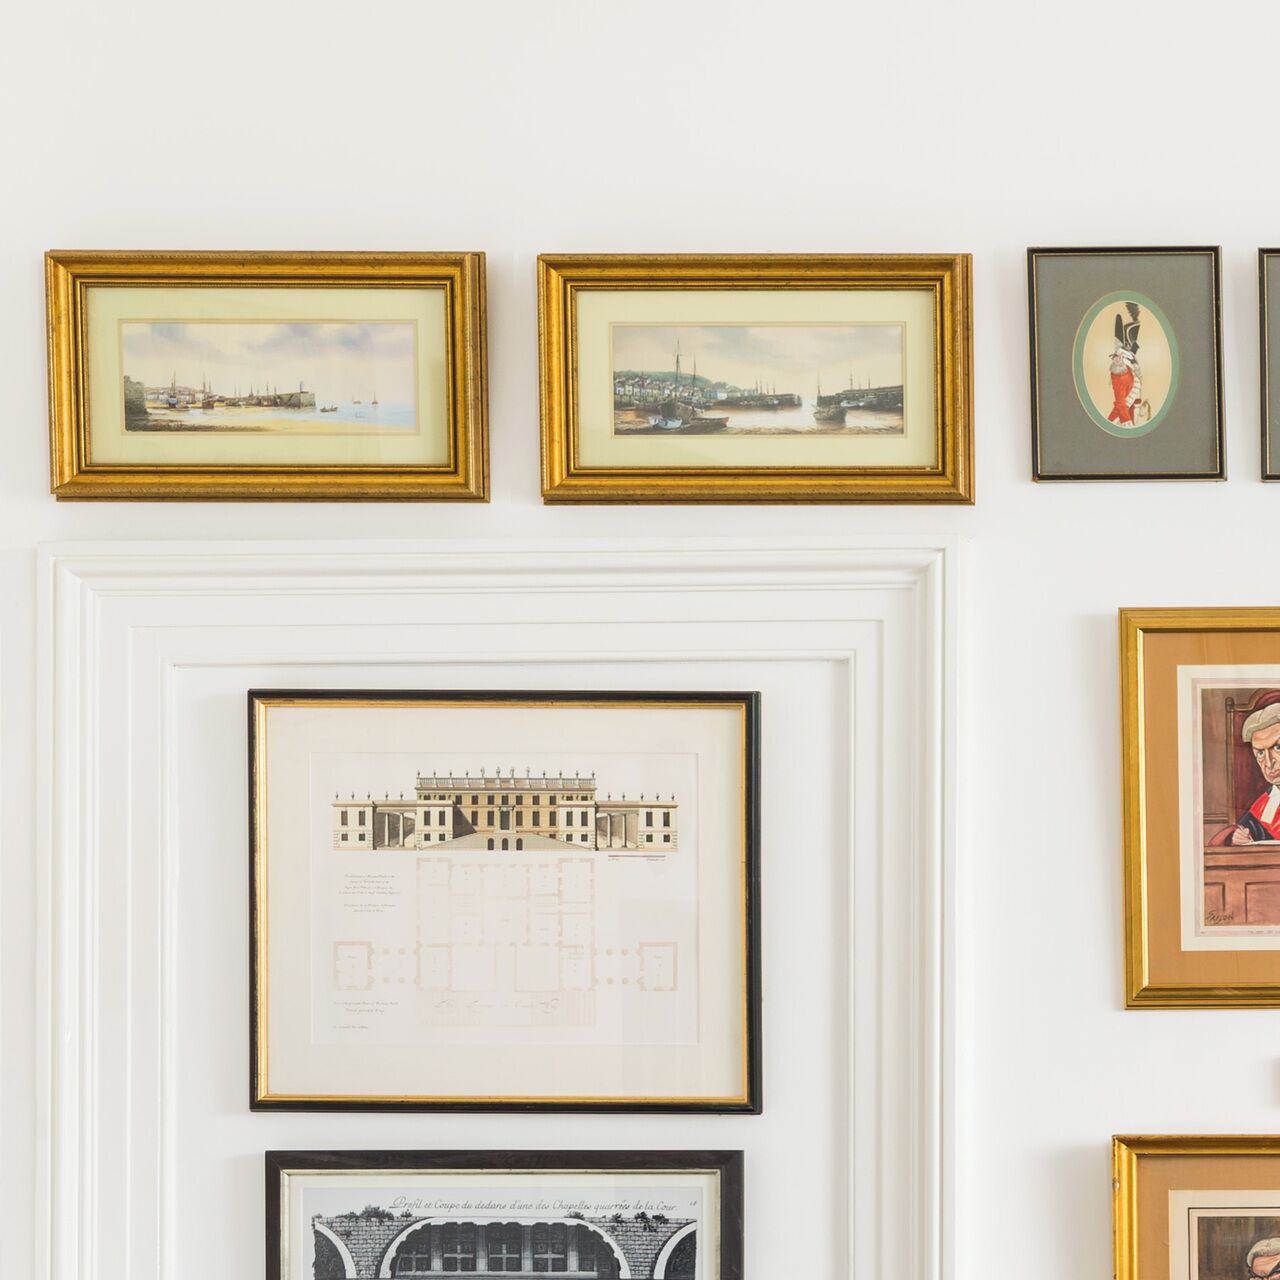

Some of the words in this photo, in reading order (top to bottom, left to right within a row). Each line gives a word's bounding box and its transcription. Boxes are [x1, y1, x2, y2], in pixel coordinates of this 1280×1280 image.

[389, 1196, 422, 1209] Profil
[434, 1199, 460, 1212] Coupe
[461, 1200, 472, 1209] du
[474, 1200, 507, 1209] dedans
[535, 1199, 550, 1209] des
[552, 1200, 592, 1213] Chapelles
[632, 1200, 644, 1209] de
[644, 1201, 654, 1210] la
